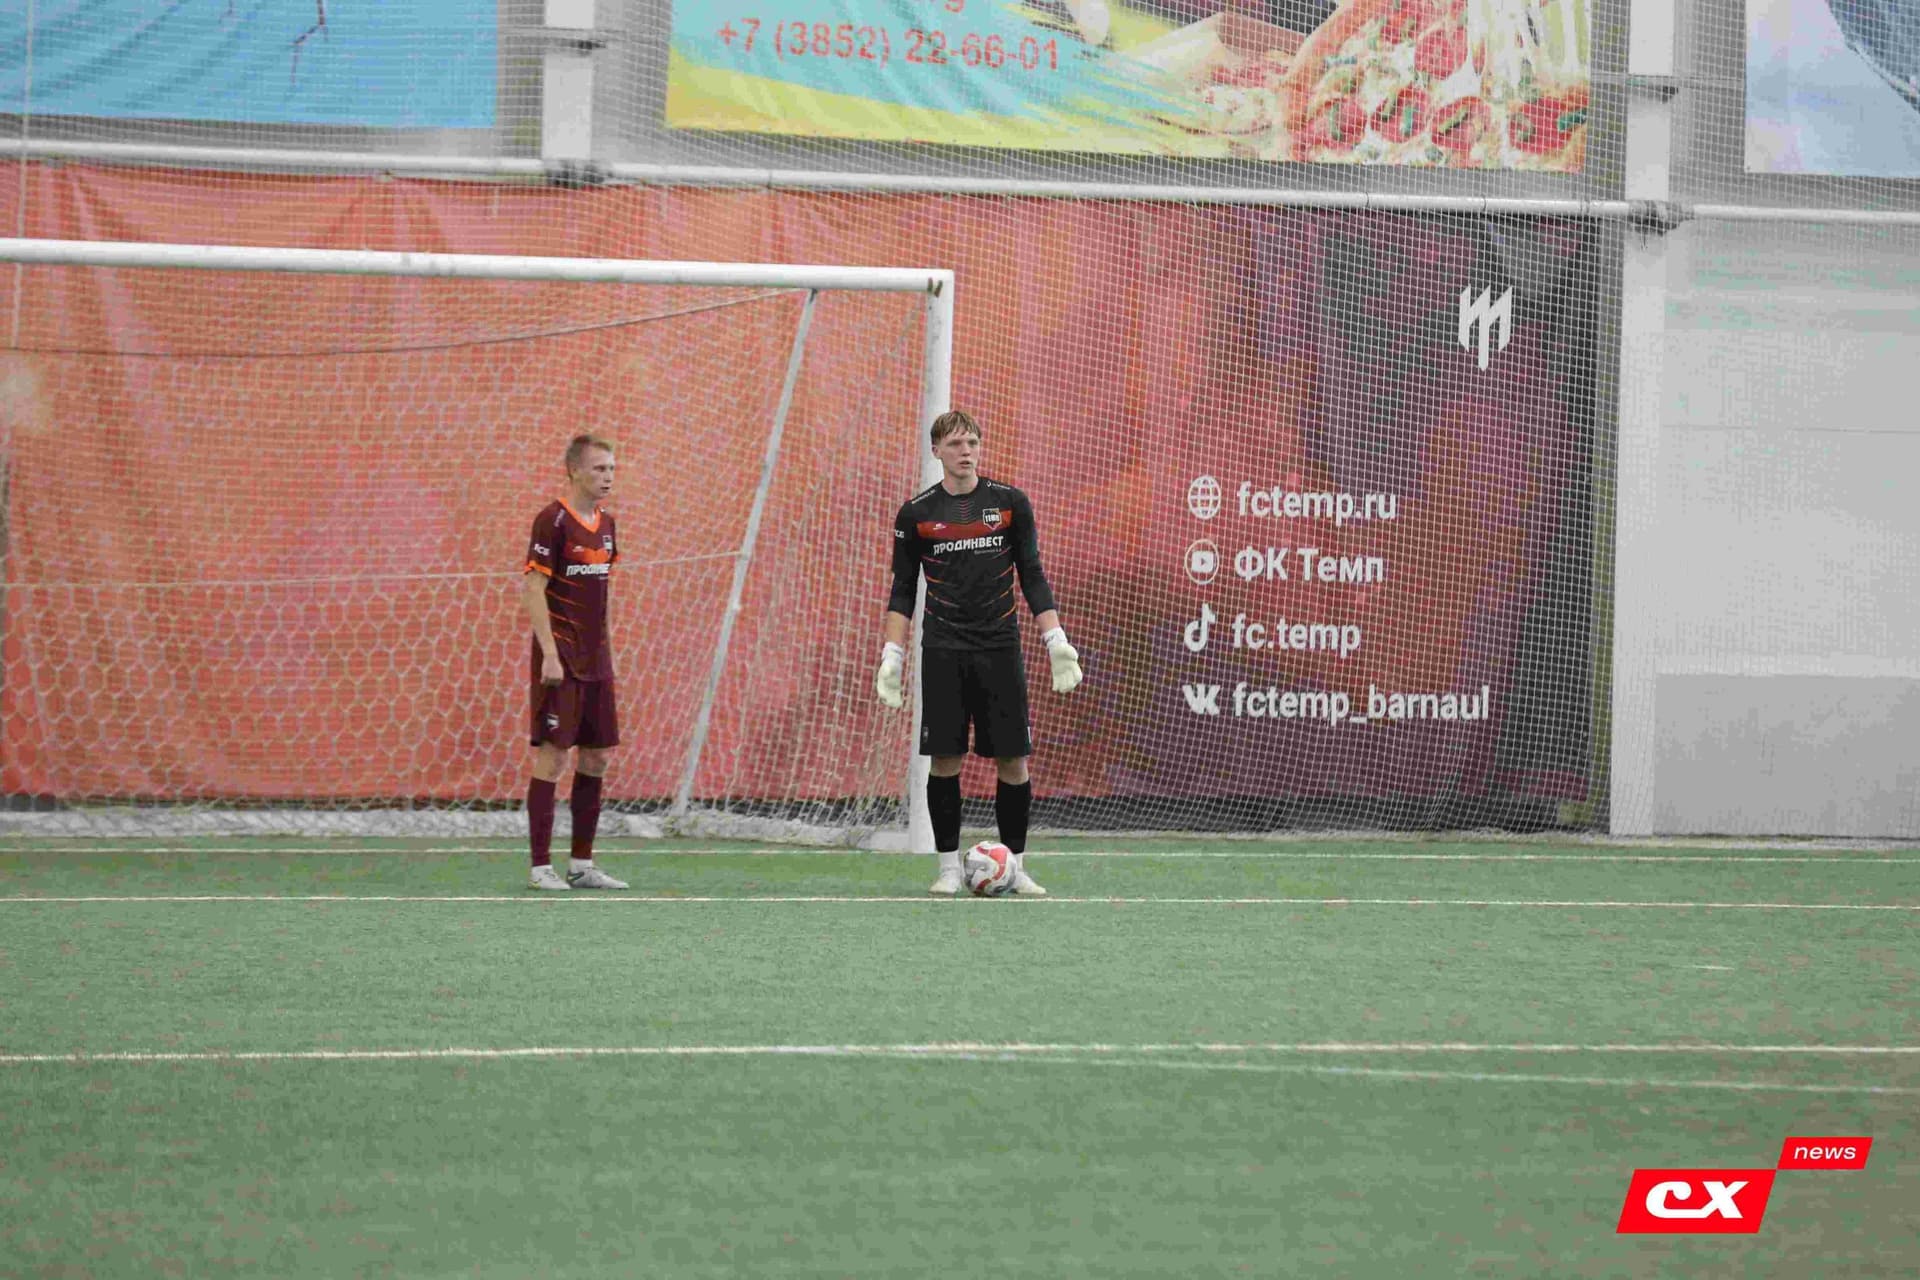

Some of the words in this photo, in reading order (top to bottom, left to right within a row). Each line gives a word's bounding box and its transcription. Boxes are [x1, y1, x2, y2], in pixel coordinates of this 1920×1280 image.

[718, 17, 760, 53] +7
[774, 20, 889, 69] (3852)
[904, 28, 1058, 70] 22-66-01
[1236, 481, 1397, 526] fctemp.ru
[933, 536, 1004, 556] ПРОДИНВЕСТ
[1234, 546, 1288, 582] ФК
[1298, 548, 1385, 582] Темп
[1232, 613, 1362, 659] fc.temp
[1232, 682, 1490, 727] fctemp_barnaul
